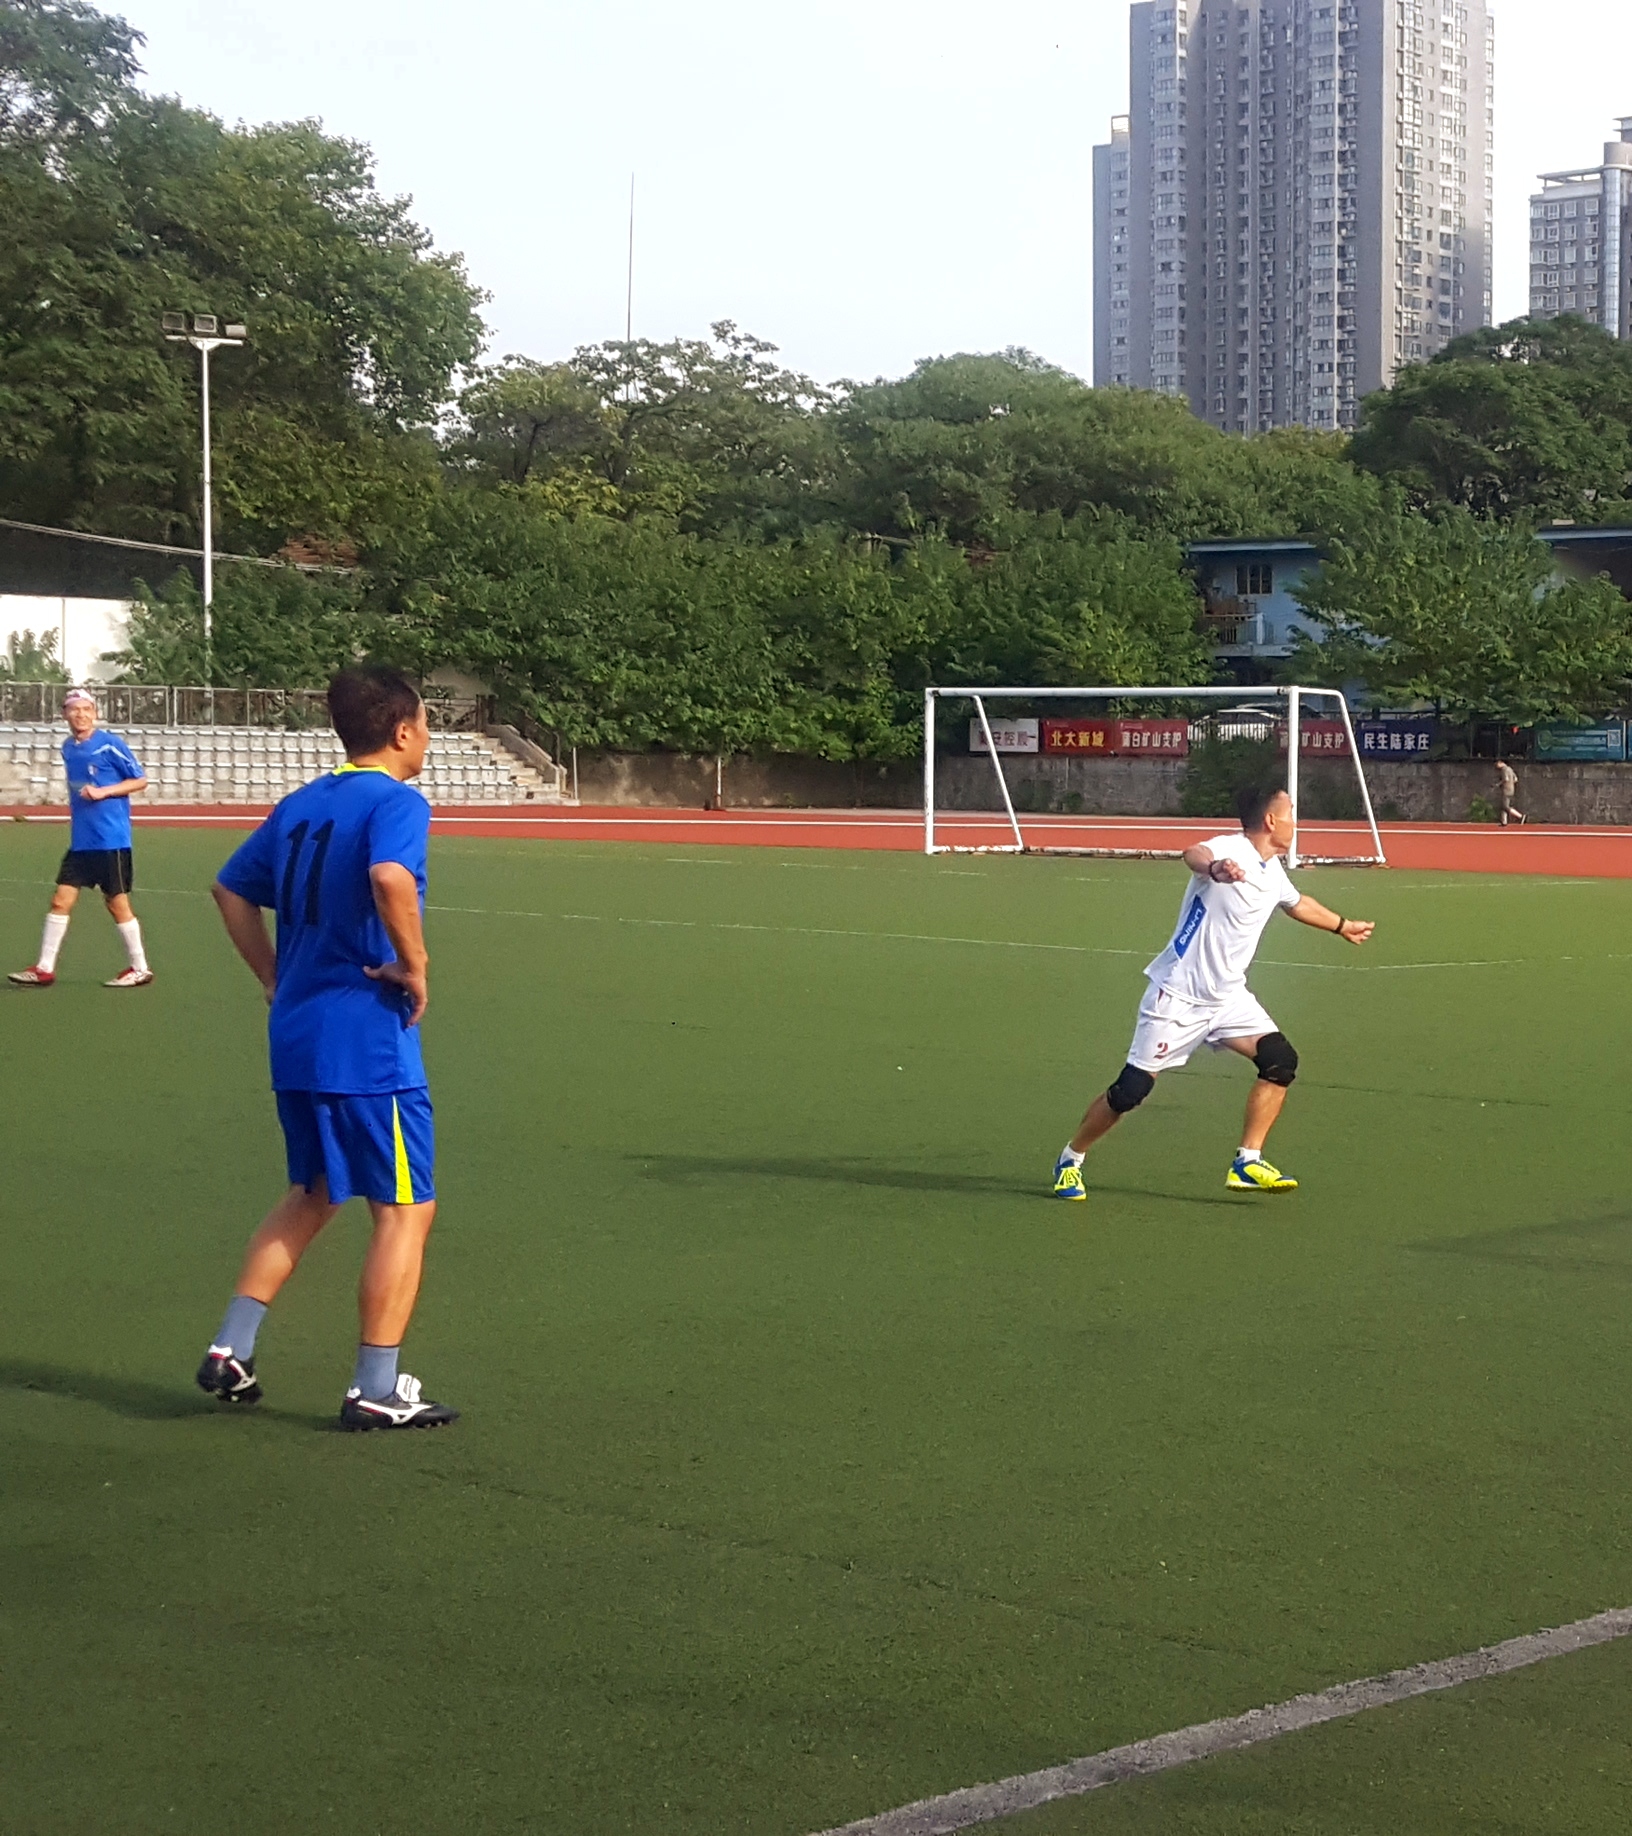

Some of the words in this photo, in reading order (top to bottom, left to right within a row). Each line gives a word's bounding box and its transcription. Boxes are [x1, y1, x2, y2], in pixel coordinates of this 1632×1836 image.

[1051, 731, 1105, 747] 北大新城
[1364, 732, 1430, 750] 民生陆家庄
[281, 819, 335, 926] 11
[1153, 1042, 1168, 1060] 2
